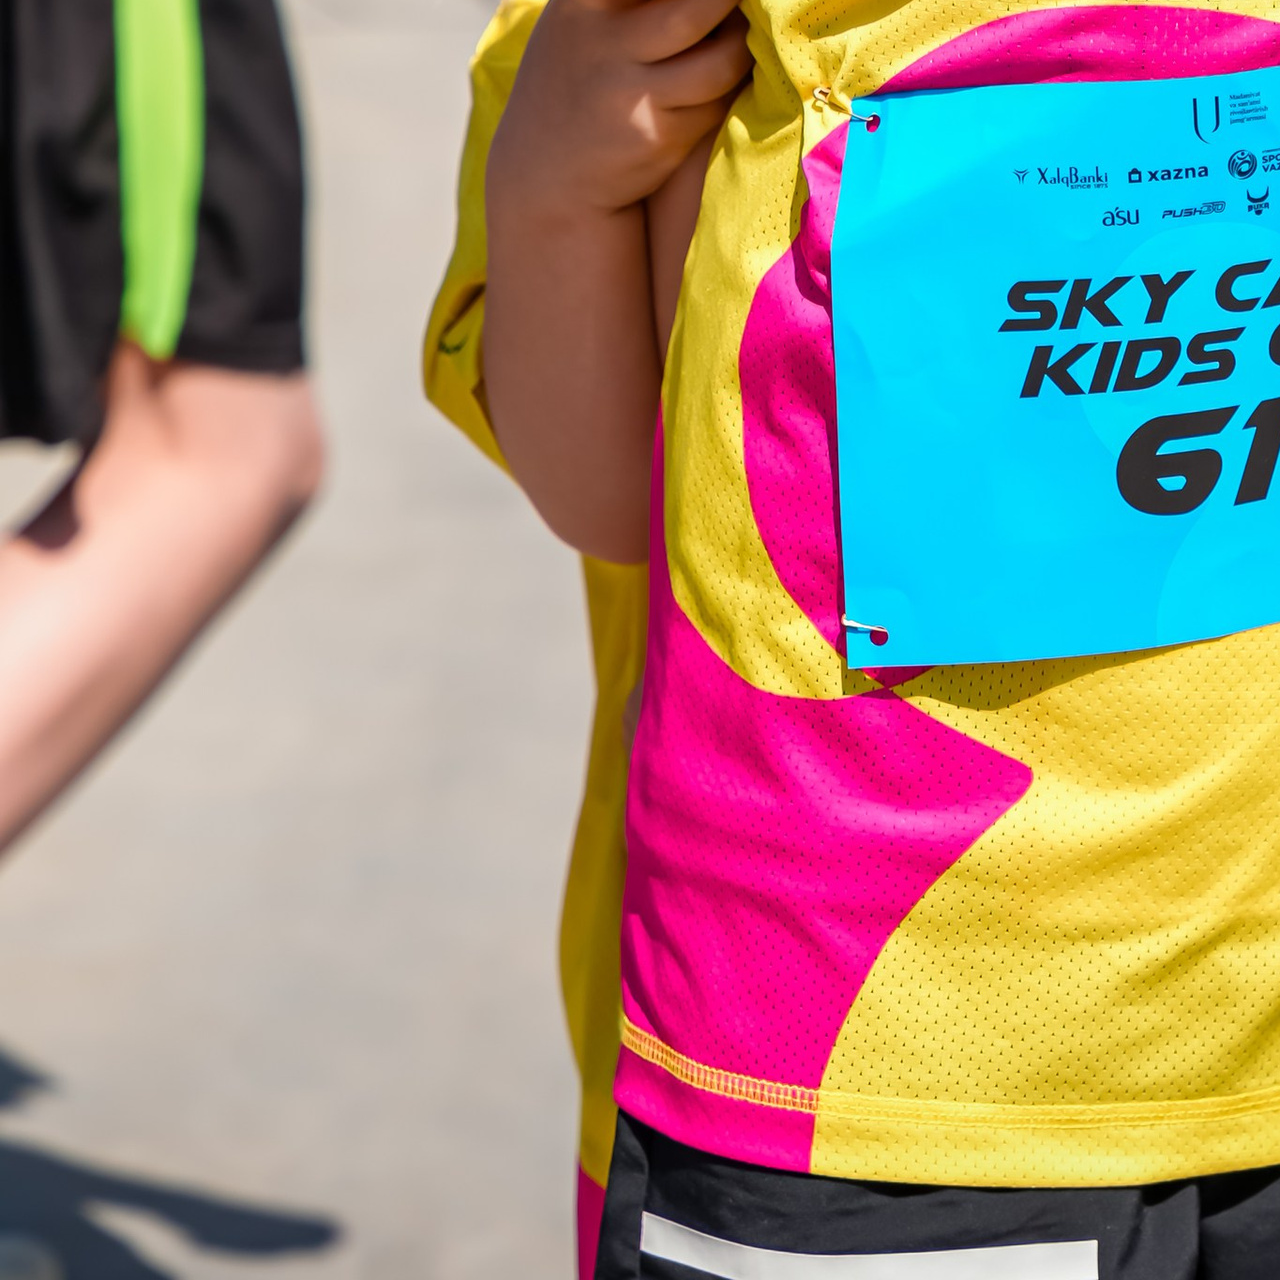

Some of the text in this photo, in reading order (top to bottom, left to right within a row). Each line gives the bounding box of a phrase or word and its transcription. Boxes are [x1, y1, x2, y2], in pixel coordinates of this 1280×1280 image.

[1148, 165, 1209, 182] xazna
[998, 269, 1197, 333] SKY
[1019, 326, 1247, 399] KIDS
